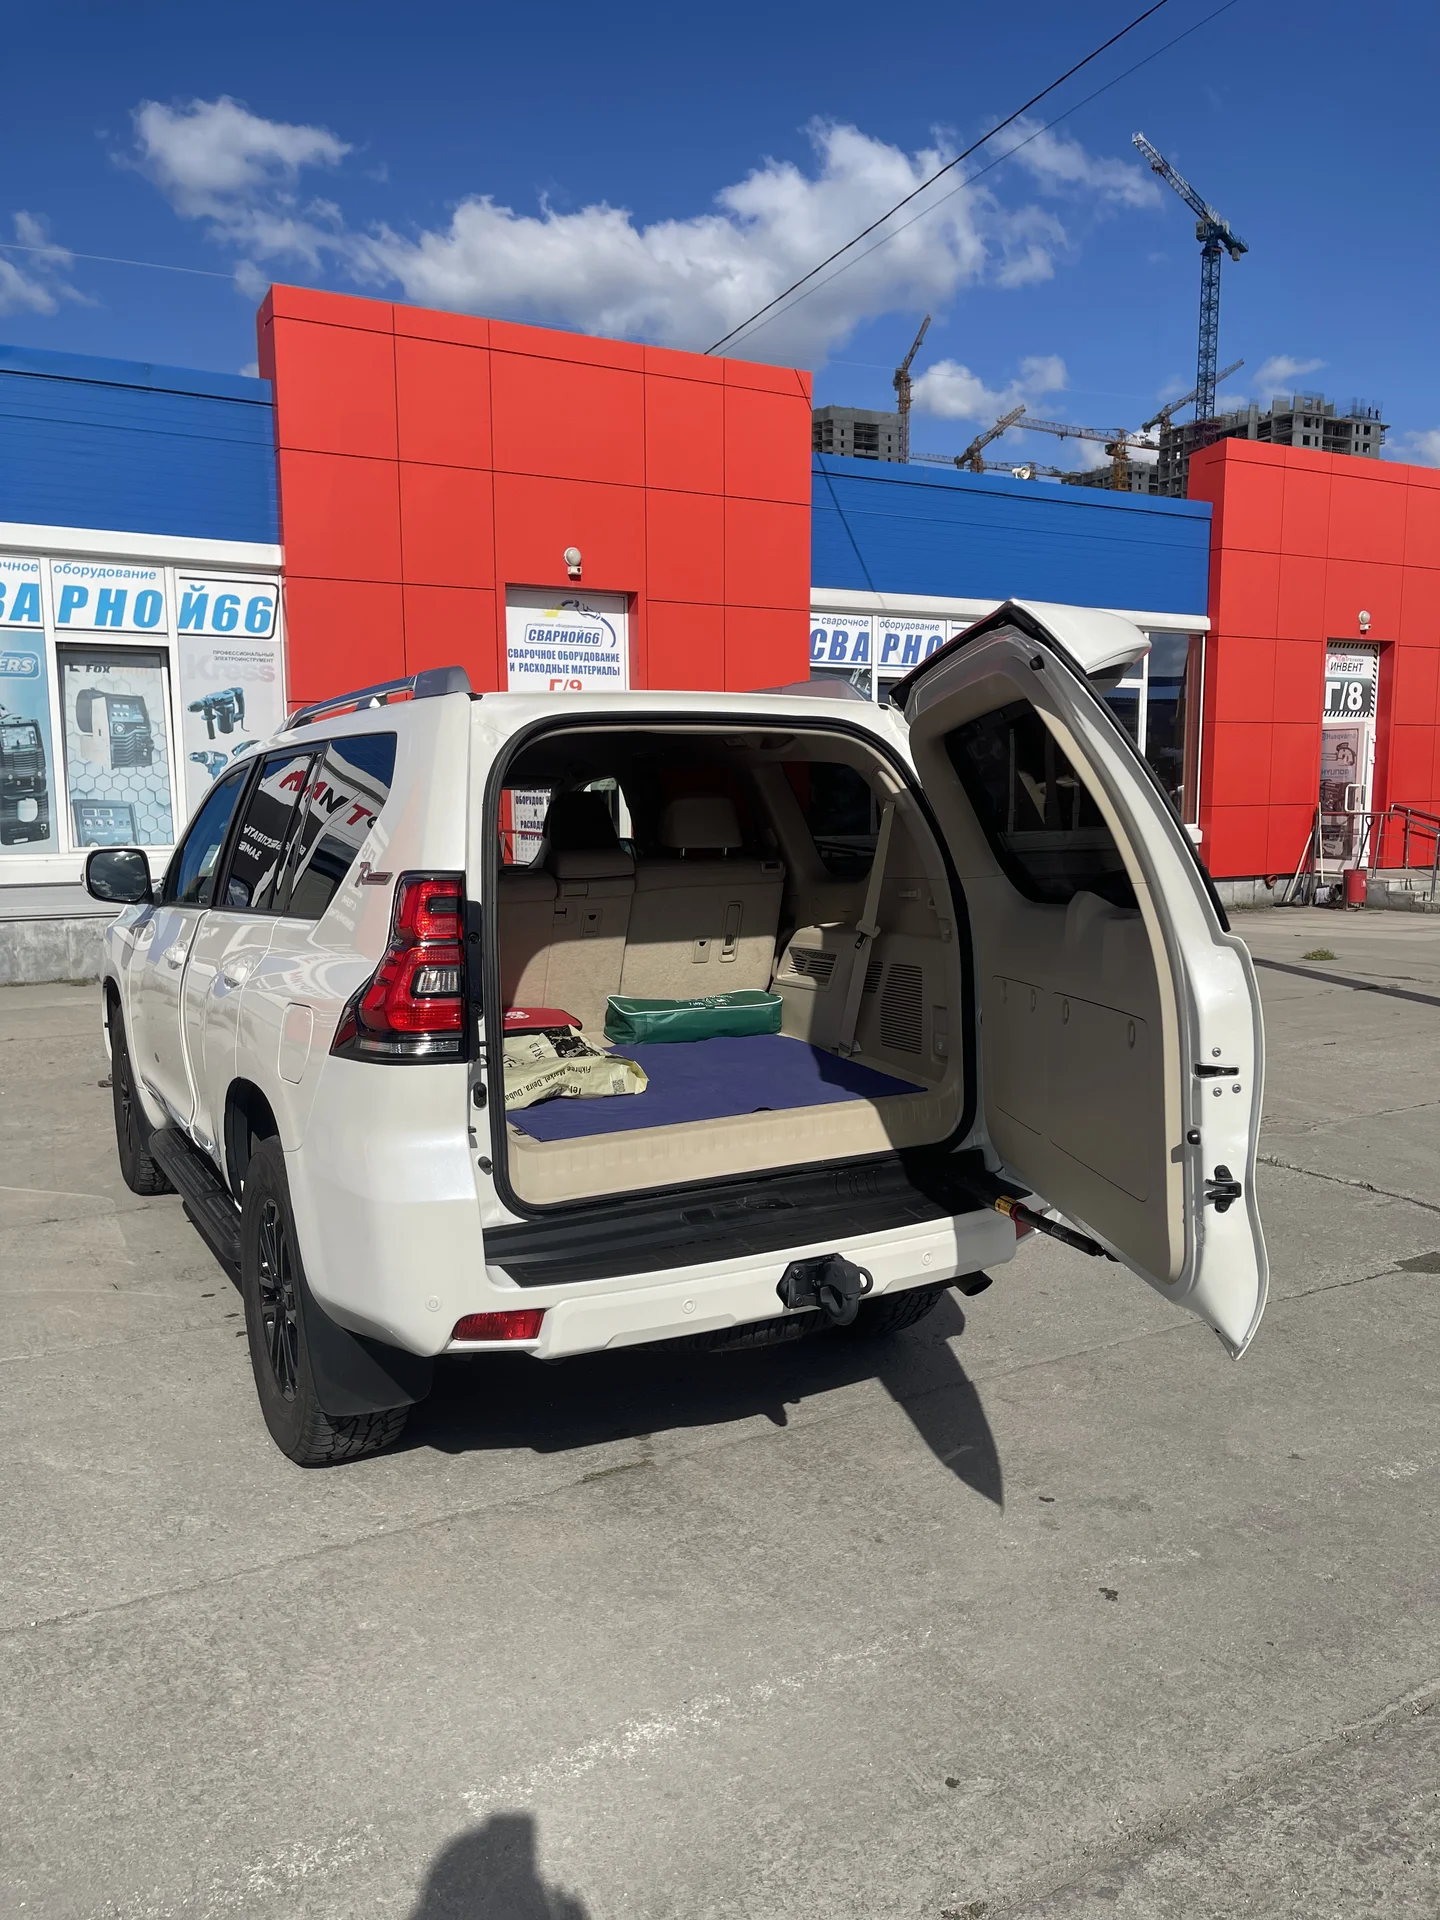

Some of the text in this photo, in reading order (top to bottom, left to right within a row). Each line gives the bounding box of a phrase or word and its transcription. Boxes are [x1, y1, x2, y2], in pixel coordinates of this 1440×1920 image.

[53, 563, 156, 580] оборудование
[821, 616, 940, 632] сварочное оборудование
[528, 628, 600, 645] СВАРНОЙ66
[508, 648, 620, 663] СВАРОЧНОЕ ОБОРУДОВАНИЕ
[509, 663, 620, 676] И РАСХОДНЫЕ МАТЕРИАЛЫ
[1330, 661, 1363, 672] ИНВЕНТ
[1324, 681, 1363, 711] Г/8
[567, 1065, 591, 1073] Fikhree
